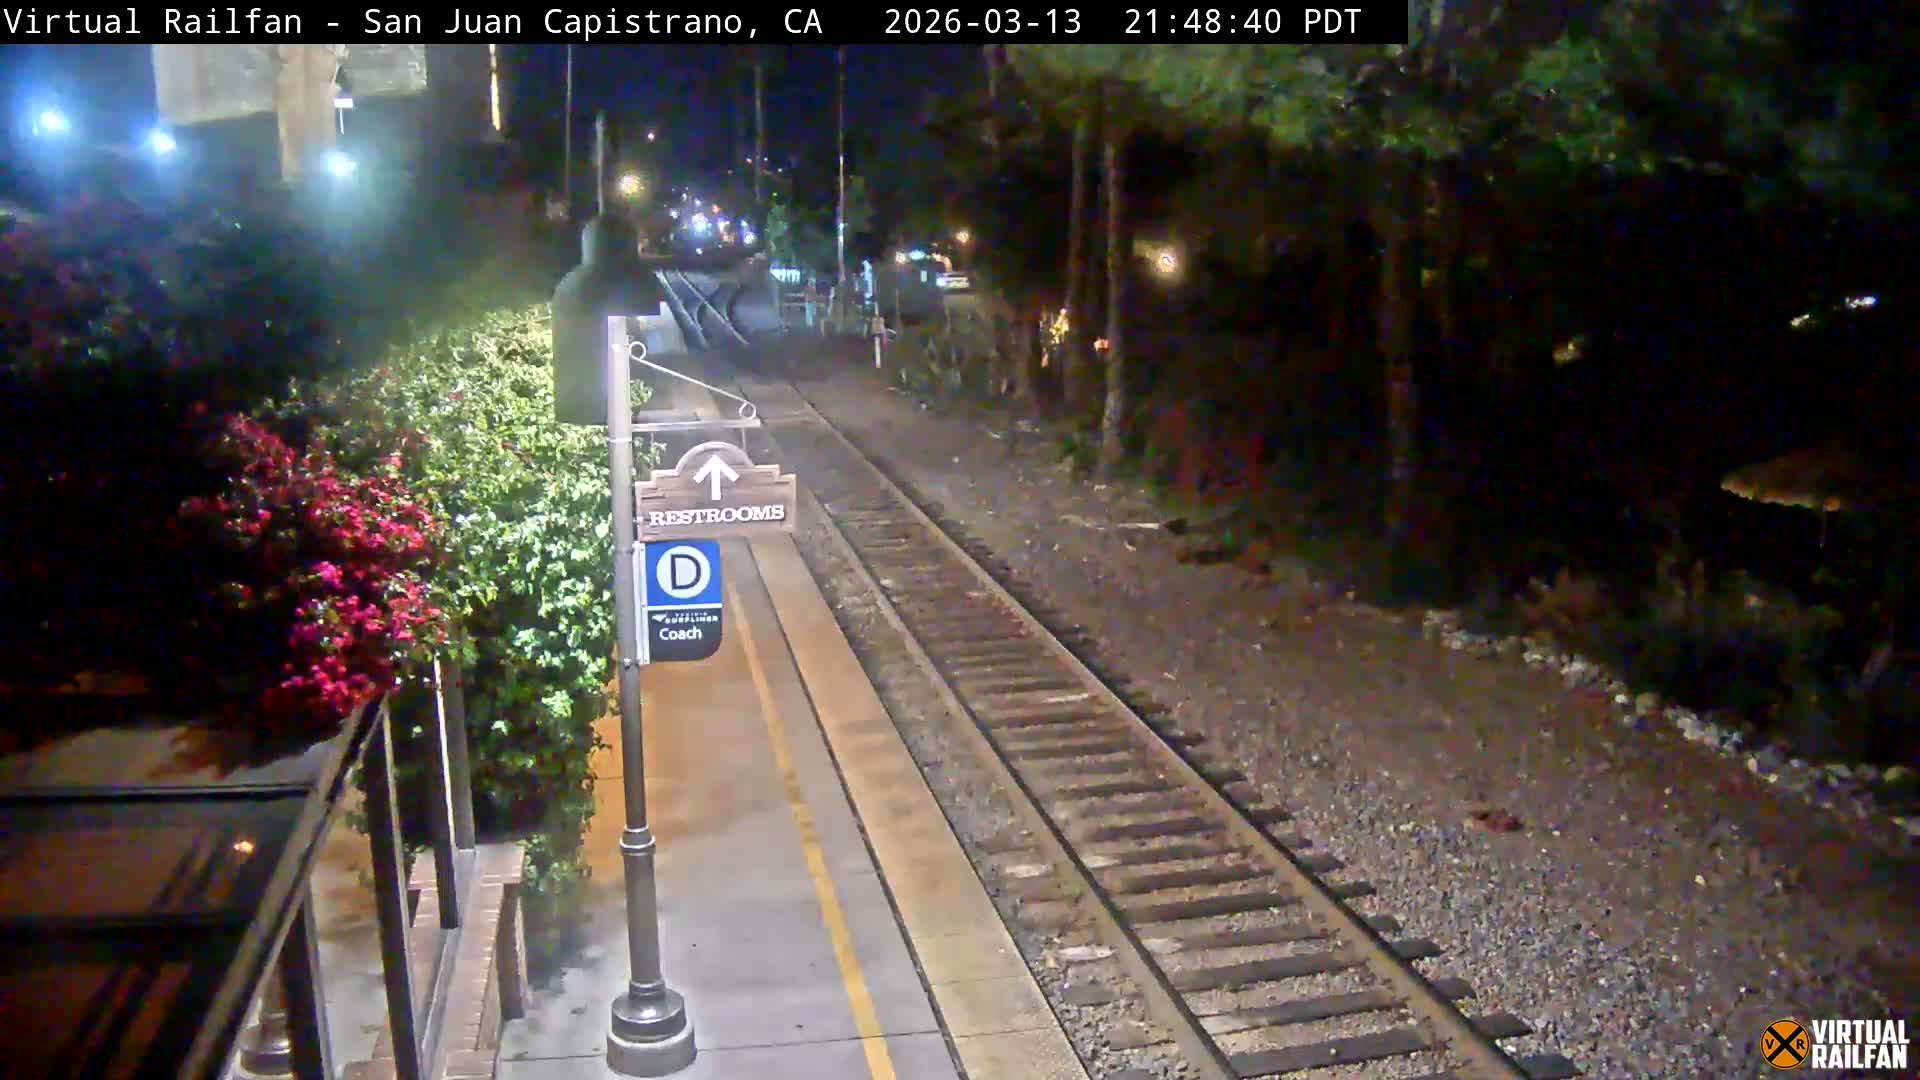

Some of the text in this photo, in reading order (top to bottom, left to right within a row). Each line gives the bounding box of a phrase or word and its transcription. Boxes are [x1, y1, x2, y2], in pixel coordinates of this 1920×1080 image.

[649, 504, 785, 526] RESTROOMS
[671, 553, 701, 591] D
[659, 626, 702, 641] Coach
